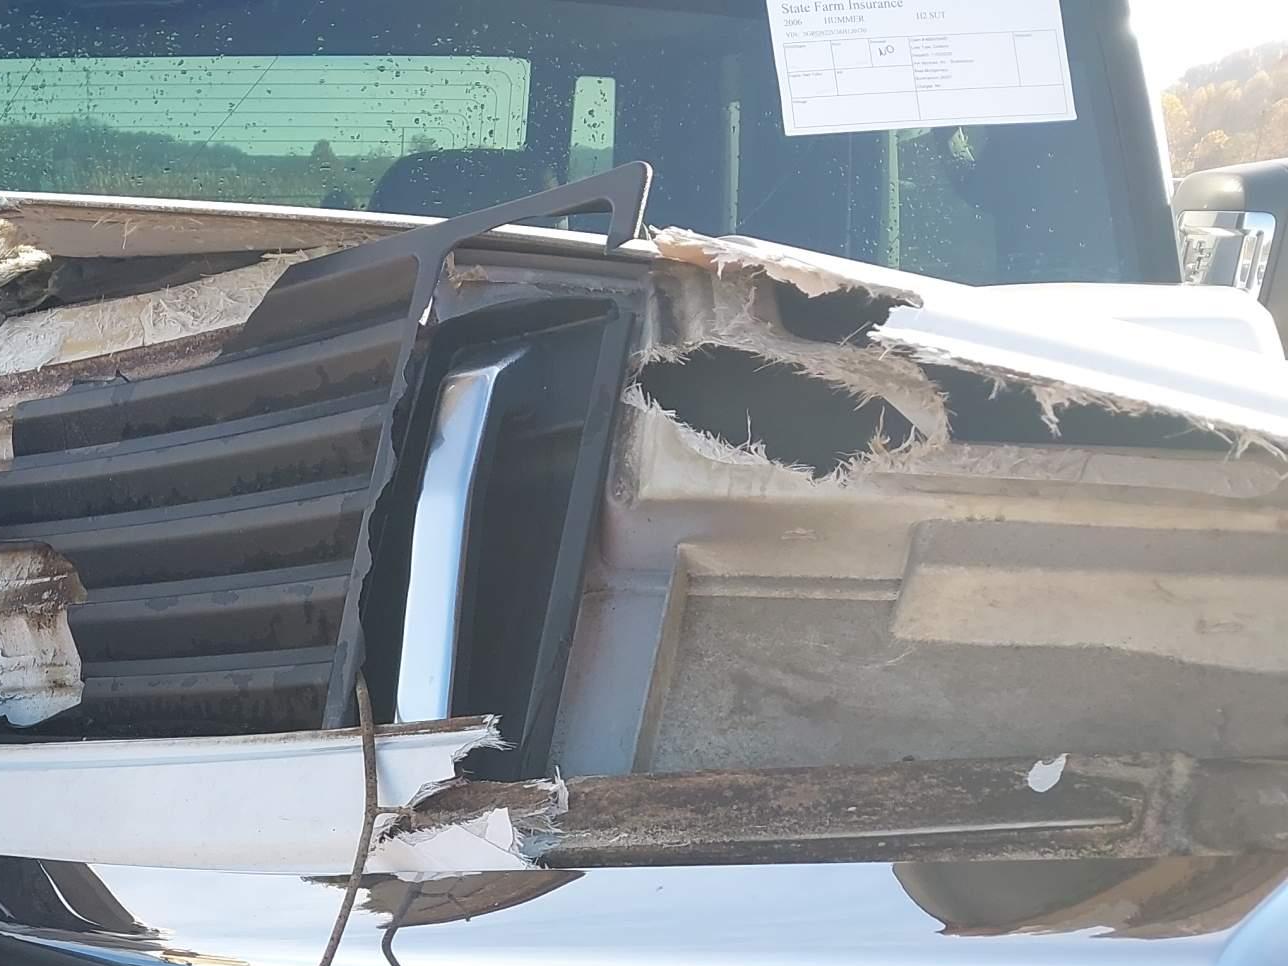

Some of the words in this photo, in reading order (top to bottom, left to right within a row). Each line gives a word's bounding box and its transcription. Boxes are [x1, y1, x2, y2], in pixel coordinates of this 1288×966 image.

[781, 2, 811, 15] State
[814, 0, 845, 12] Farm
[848, 0, 904, 11] Insurance
[783, 18, 803, 27] 2006
[823, 15, 865, 25] HUMMER
